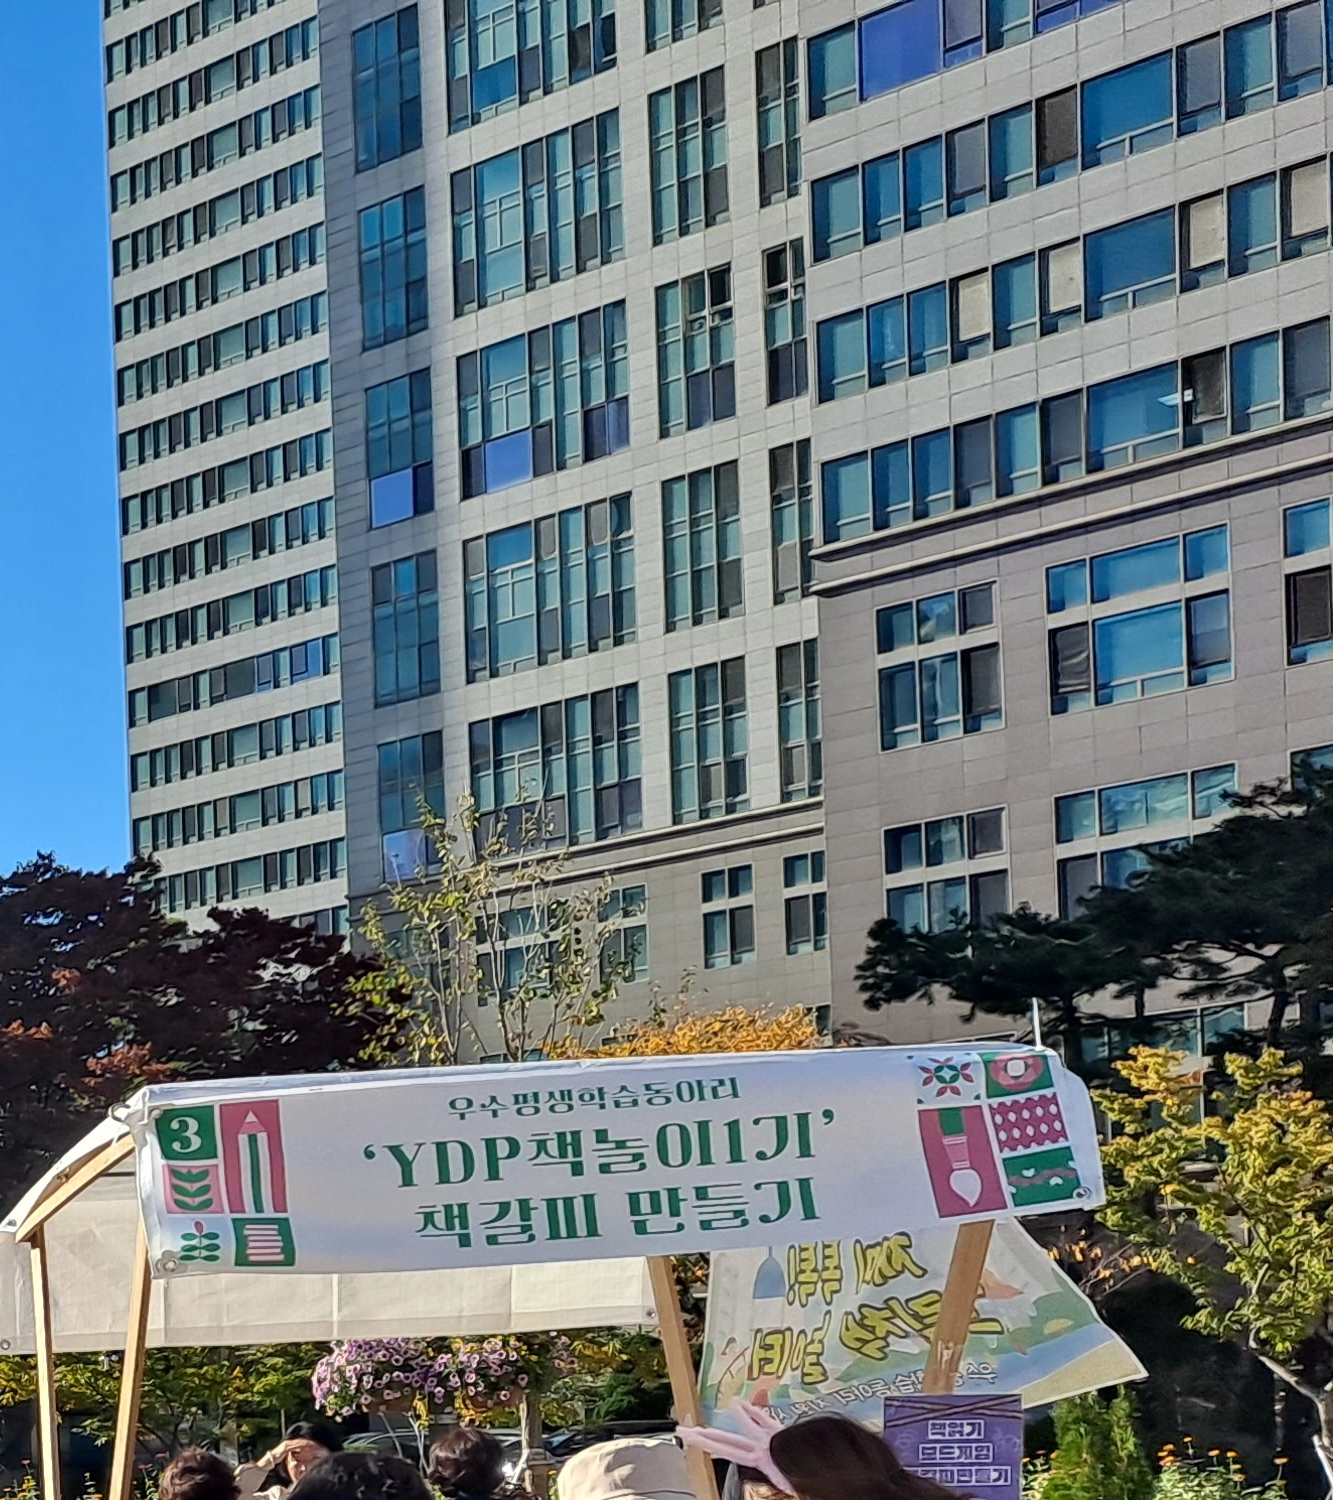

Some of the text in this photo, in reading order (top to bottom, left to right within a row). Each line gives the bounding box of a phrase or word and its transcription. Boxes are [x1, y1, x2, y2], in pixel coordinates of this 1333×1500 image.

[448, 1077, 742, 1120] 우수평생학습동아리
[170, 1117, 202, 1153] 3
[414, 1177, 821, 1249] 책갈피 만들기
